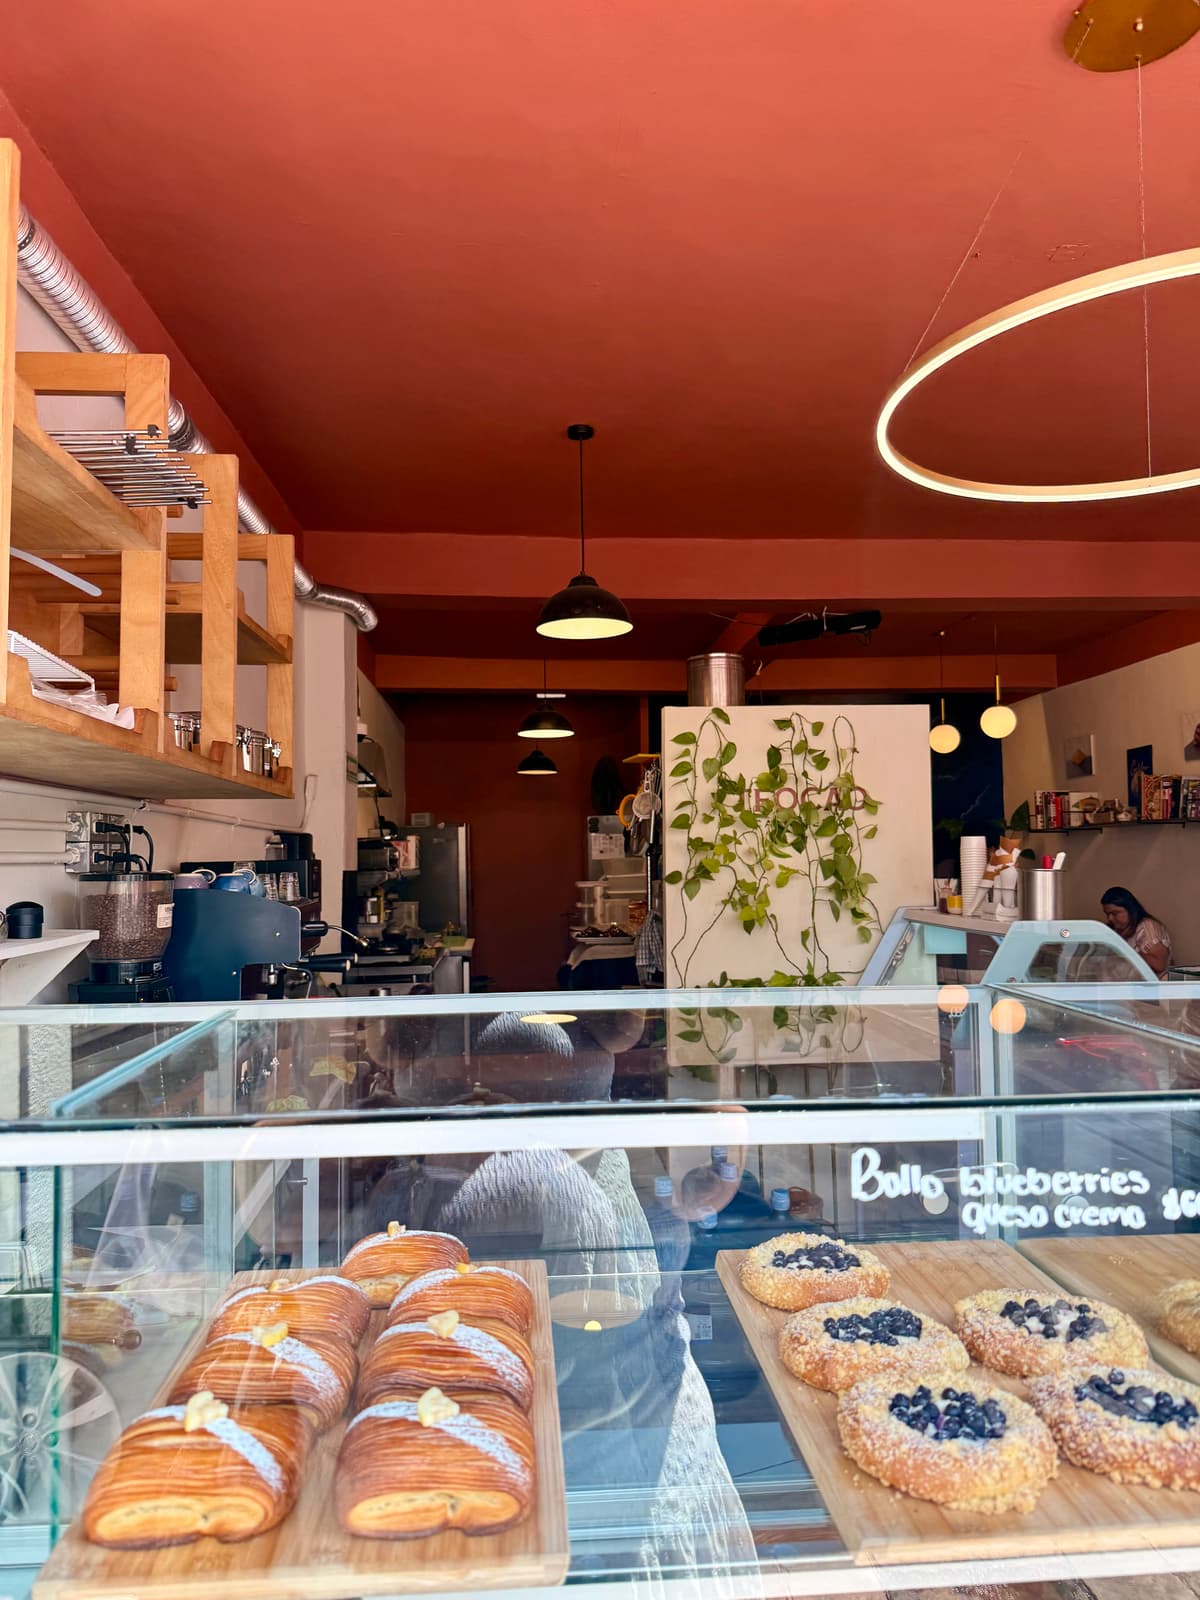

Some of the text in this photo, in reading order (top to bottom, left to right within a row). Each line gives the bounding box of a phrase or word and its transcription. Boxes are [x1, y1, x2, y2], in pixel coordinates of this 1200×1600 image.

[851, 1147, 1151, 1202] Bollo blueberries
[962, 1202, 1049, 1235] queso
